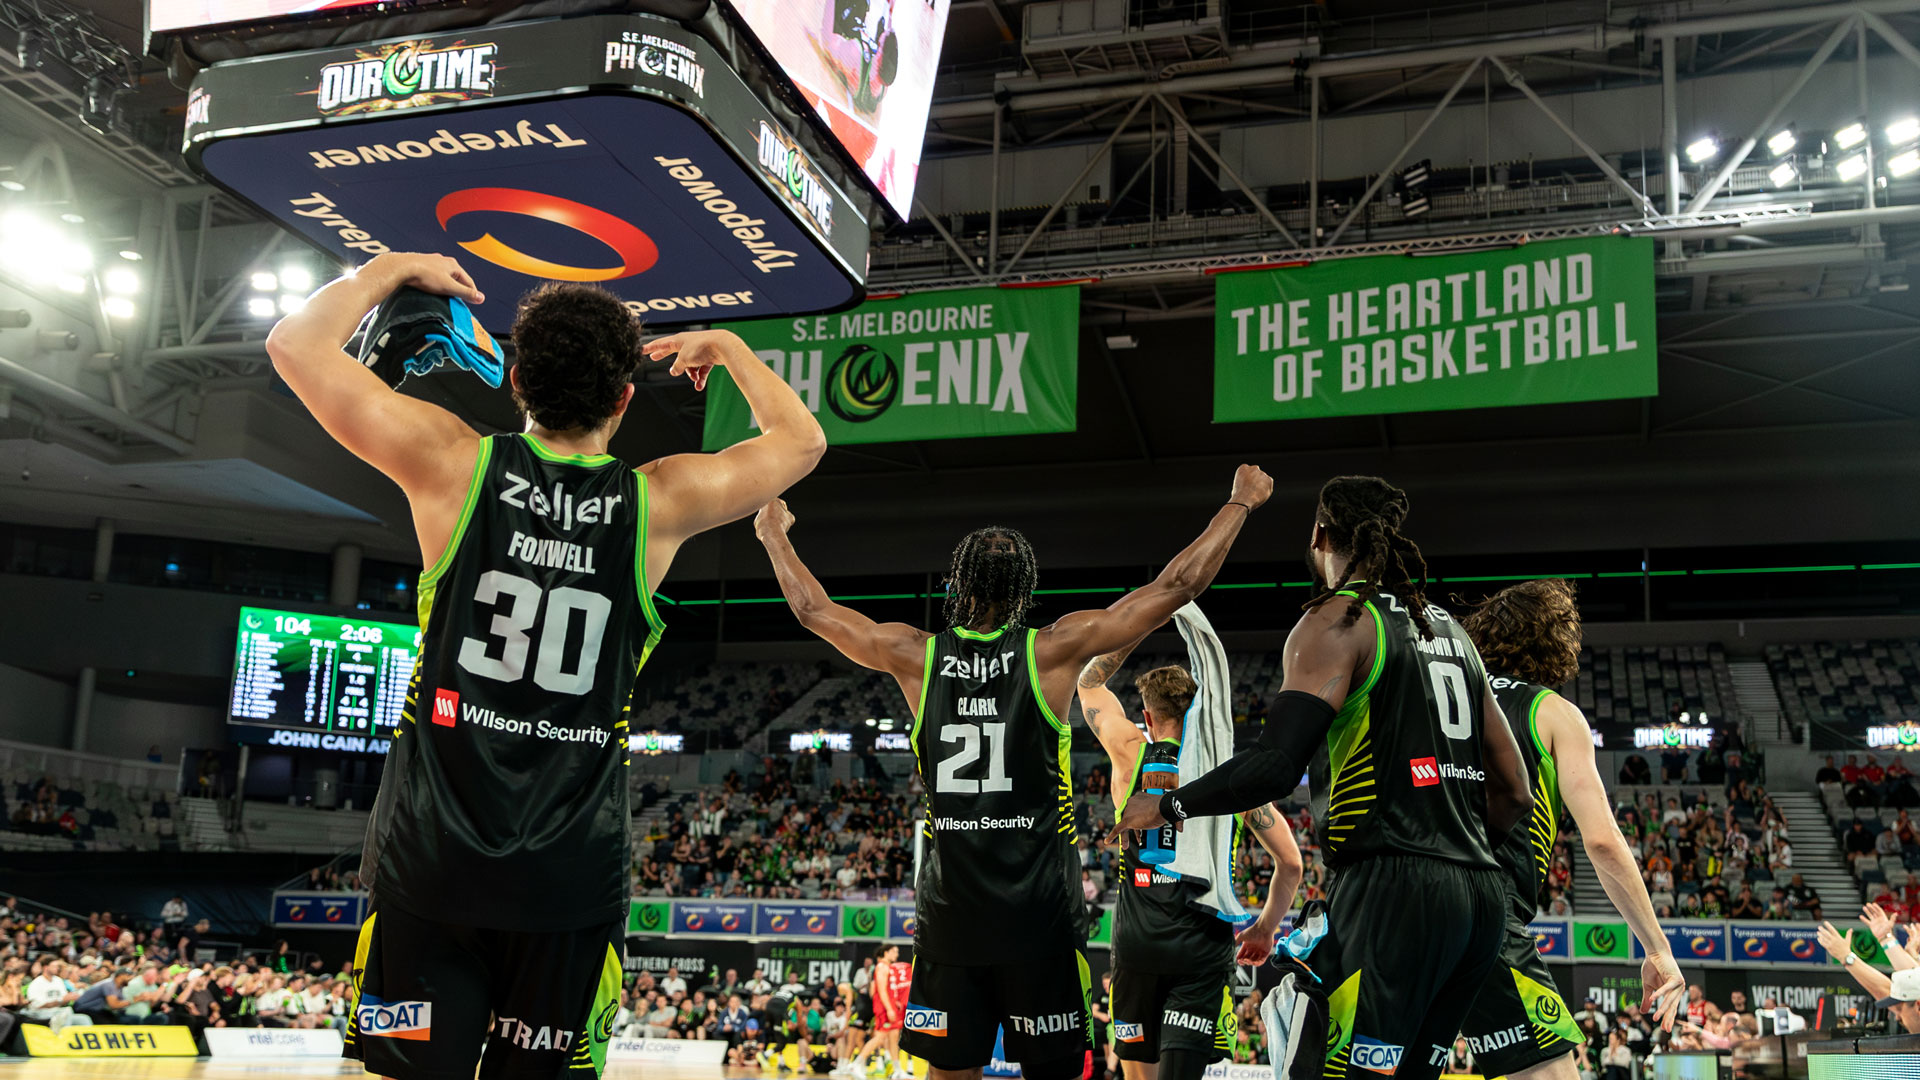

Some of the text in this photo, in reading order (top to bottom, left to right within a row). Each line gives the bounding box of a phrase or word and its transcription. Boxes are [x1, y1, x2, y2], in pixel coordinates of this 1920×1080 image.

[622, 31, 697, 62] S.E. MELBOURNE
[320, 45, 493, 110] OUR TIME
[308, 119, 588, 169] Tyrepower
[759, 122, 833, 238] OUR TIME
[289, 191, 391, 255] Tyrep
[653, 155, 799, 274] Tyrepower
[625, 290, 753, 317] power
[1231, 252, 1594, 356] THE HEARTLAND
[792, 304, 993, 343] S.E. MELBOURNE
[1273, 301, 1639, 403] OF BASKETBALL
[507, 530, 597, 575] FOXWELL
[274, 615, 311, 636] 104
[457, 569, 613, 696] 30
[957, 696, 999, 717] CLARK
[1428, 660, 1472, 740] 0
[268, 729, 320, 749] JOHN
[321, 734, 366, 753] CAIN
[536, 719, 612, 749] Security
[1866, 726, 1899, 748] OUR
[936, 722, 1013, 794] 21
[934, 815, 1035, 831] Wilson Security
[358, 1002, 424, 1032] GOAT
[906, 1011, 943, 1028] GOAT
[1009, 1010, 1080, 1036] TRADIE
[1163, 1010, 1213, 1035] TRADIE
[68, 1032, 156, 1050] JB HI-FI
[498, 1016, 574, 1052] TRAD
[1353, 1046, 1402, 1067] GOAT
